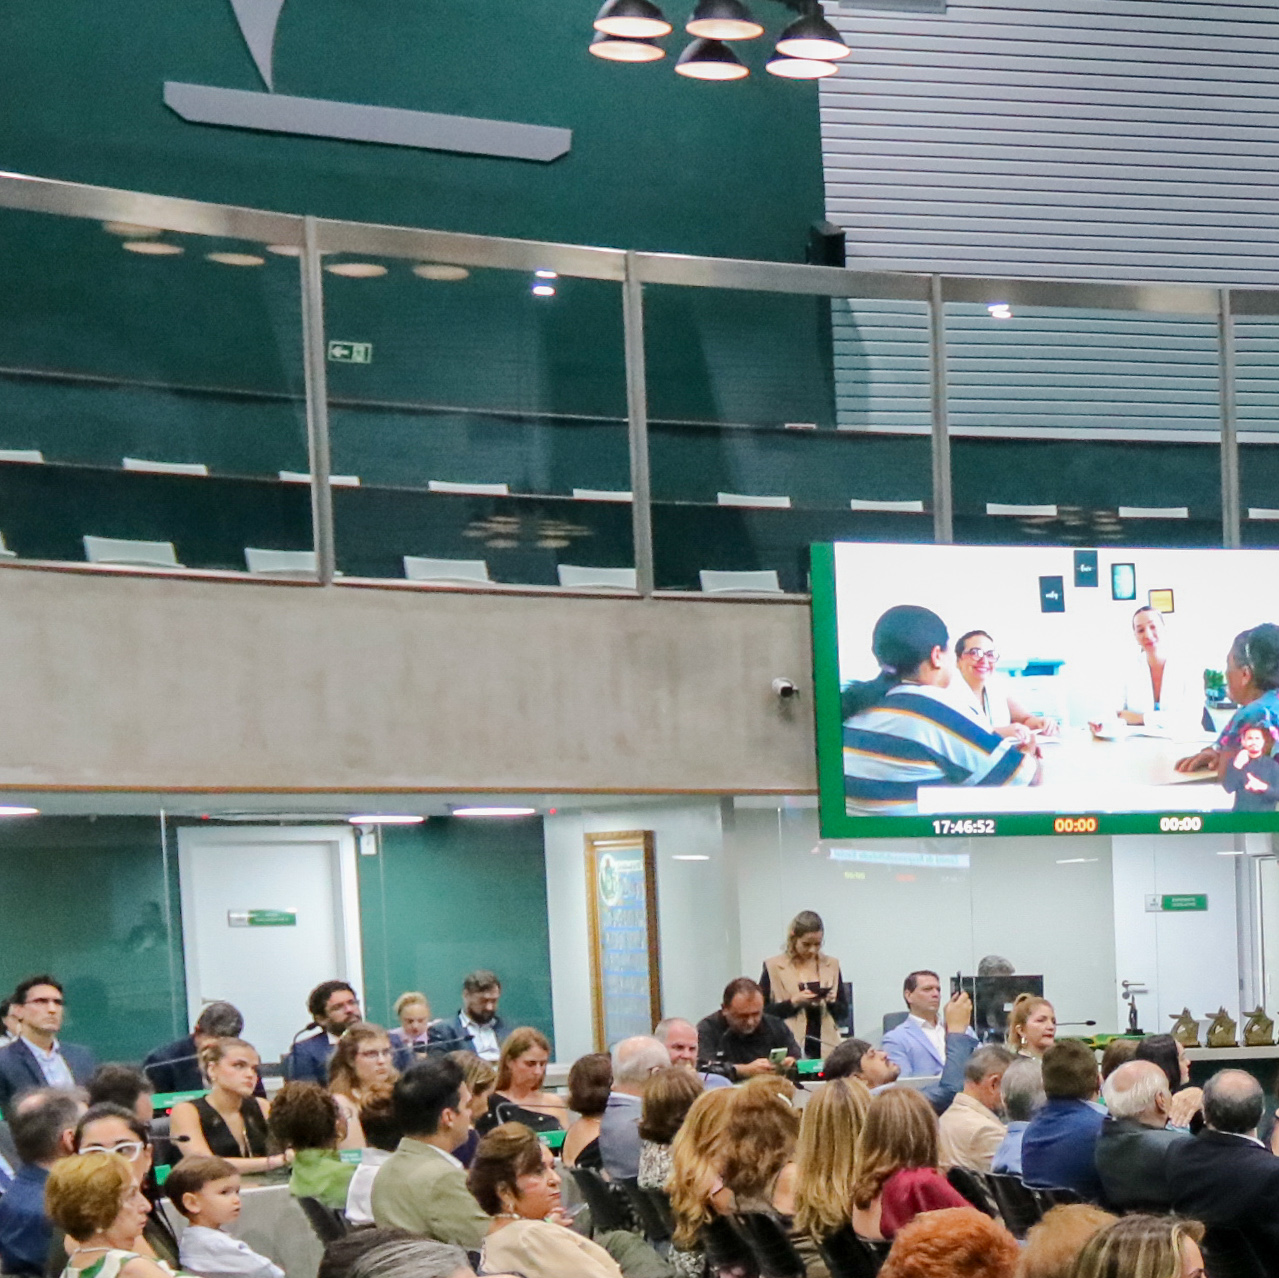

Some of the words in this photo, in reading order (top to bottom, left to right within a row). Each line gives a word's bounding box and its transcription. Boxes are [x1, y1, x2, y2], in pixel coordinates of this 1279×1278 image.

[932, 819, 996, 835] 17:46:52
[1054, 817, 1097, 833] 00:00
[1160, 816, 1201, 832] 00:00
